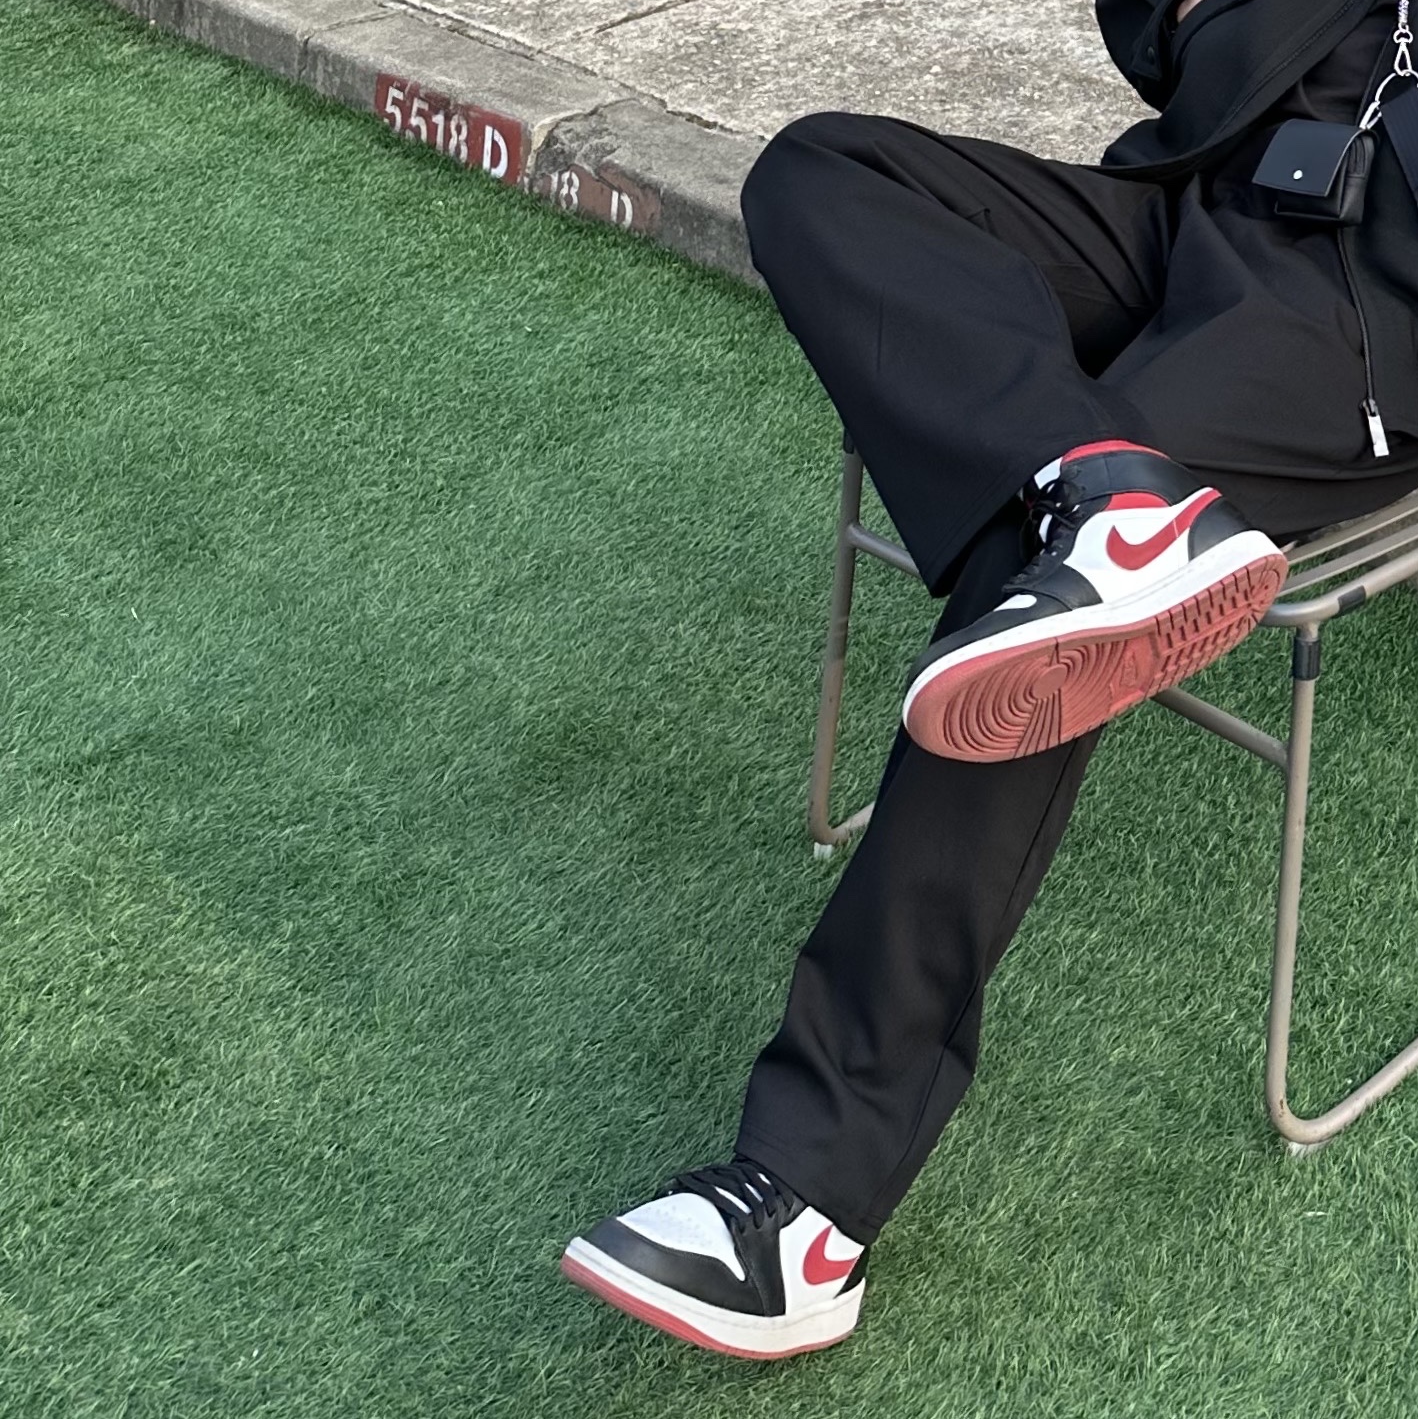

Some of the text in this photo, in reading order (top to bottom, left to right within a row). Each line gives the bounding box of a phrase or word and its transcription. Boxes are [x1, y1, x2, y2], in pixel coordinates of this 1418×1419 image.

[383, 85, 509, 179] 5518 D
[610, 189, 633, 229] D
